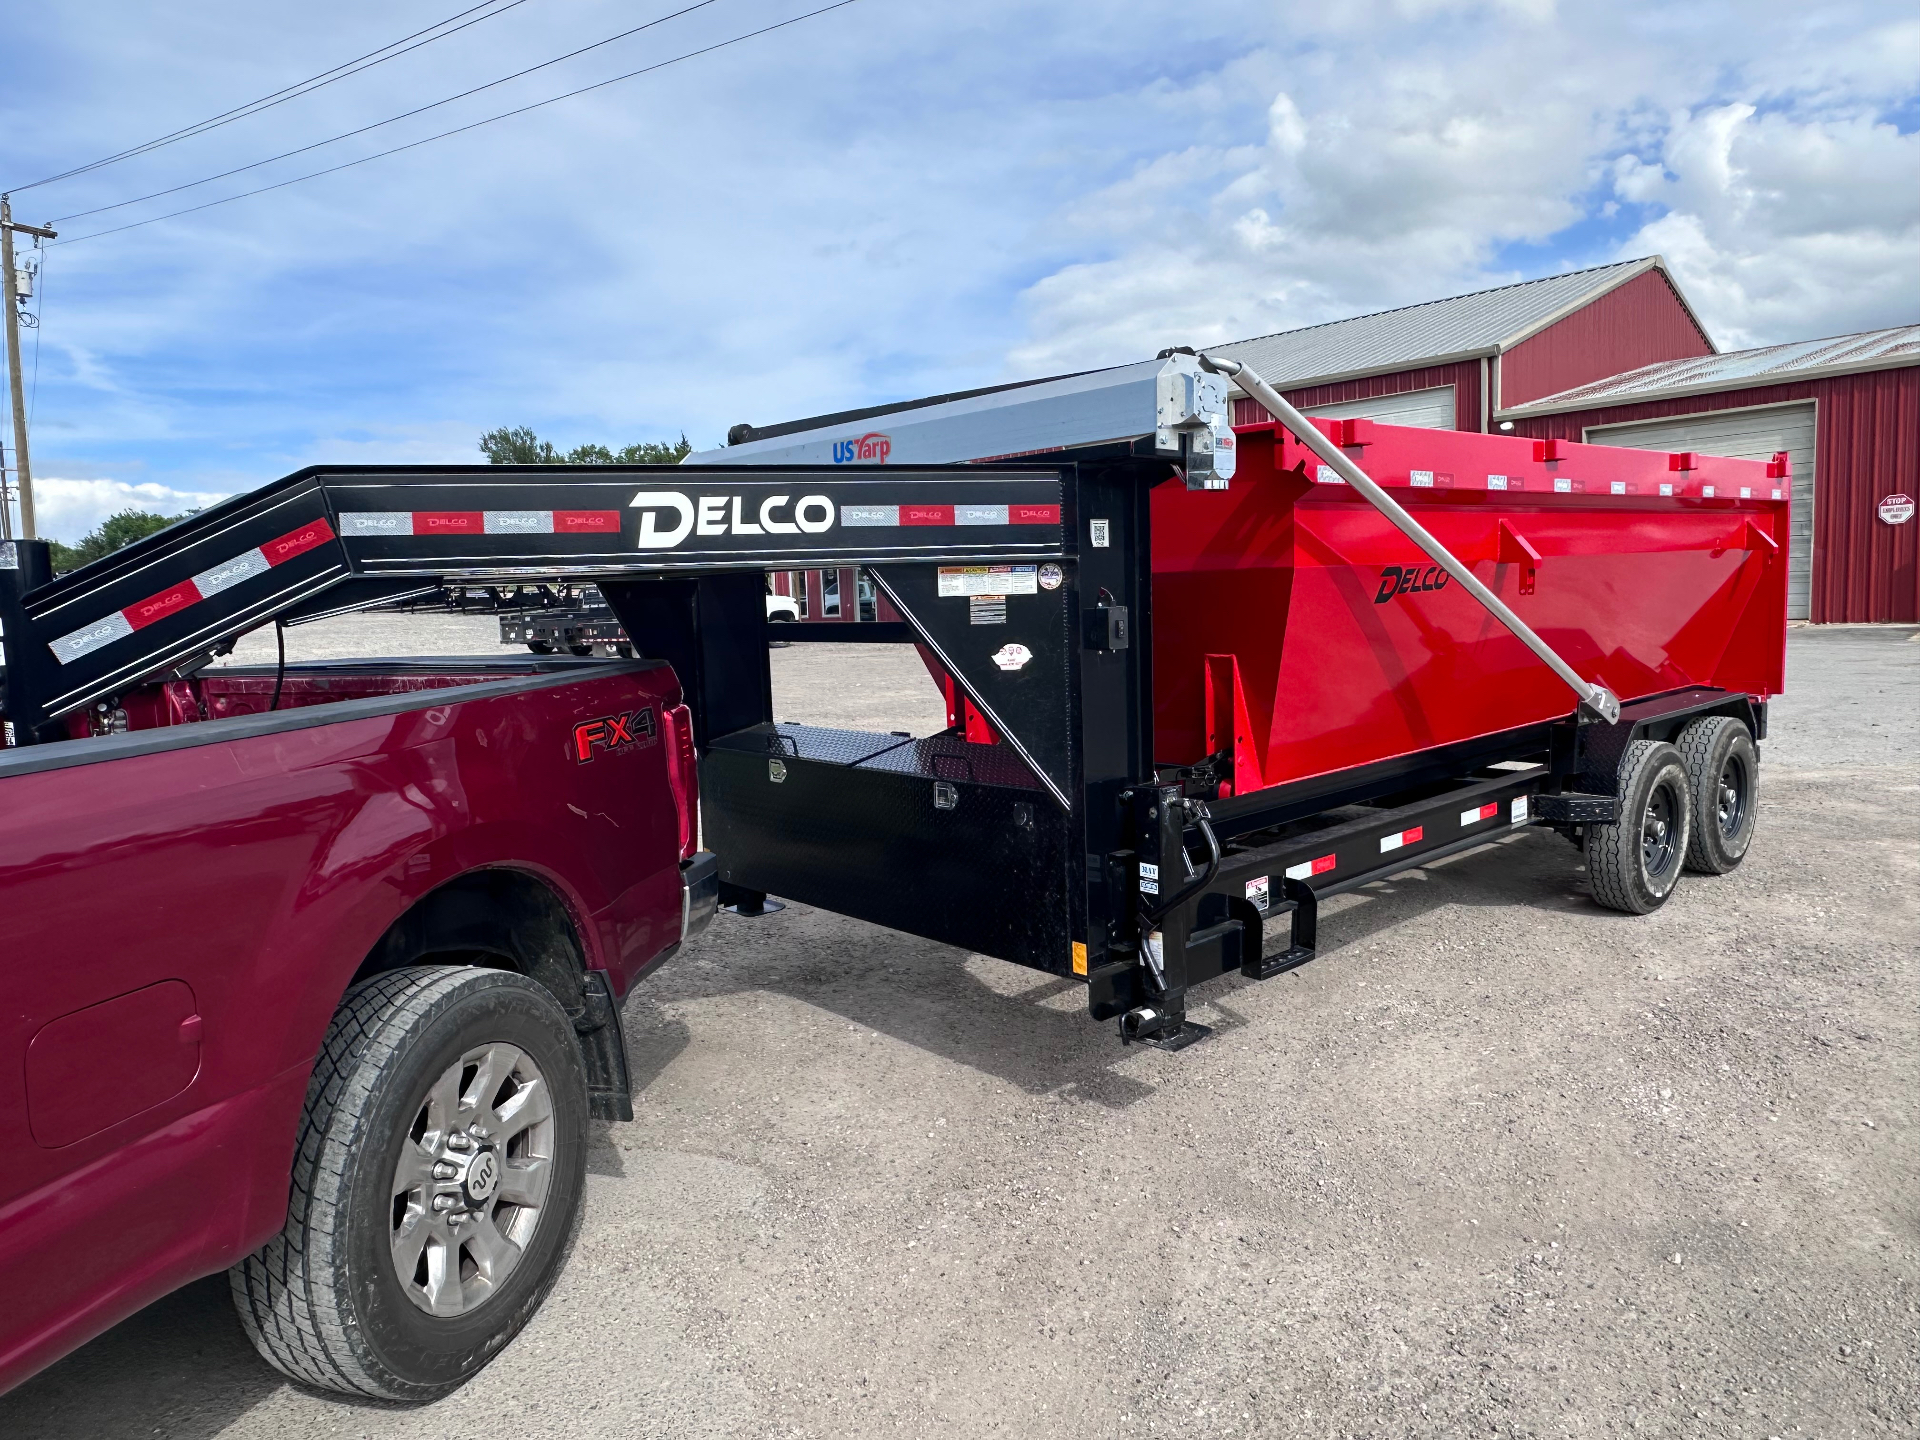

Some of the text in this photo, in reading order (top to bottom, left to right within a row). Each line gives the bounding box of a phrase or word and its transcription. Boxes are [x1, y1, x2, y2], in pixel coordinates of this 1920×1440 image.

[427, 518, 468, 527] DELCO
[565, 517, 605, 525] DELCO
[628, 491, 835, 549] DELCO
[1374, 566, 1449, 604] DELCO
[572, 706, 657, 766] FX4
